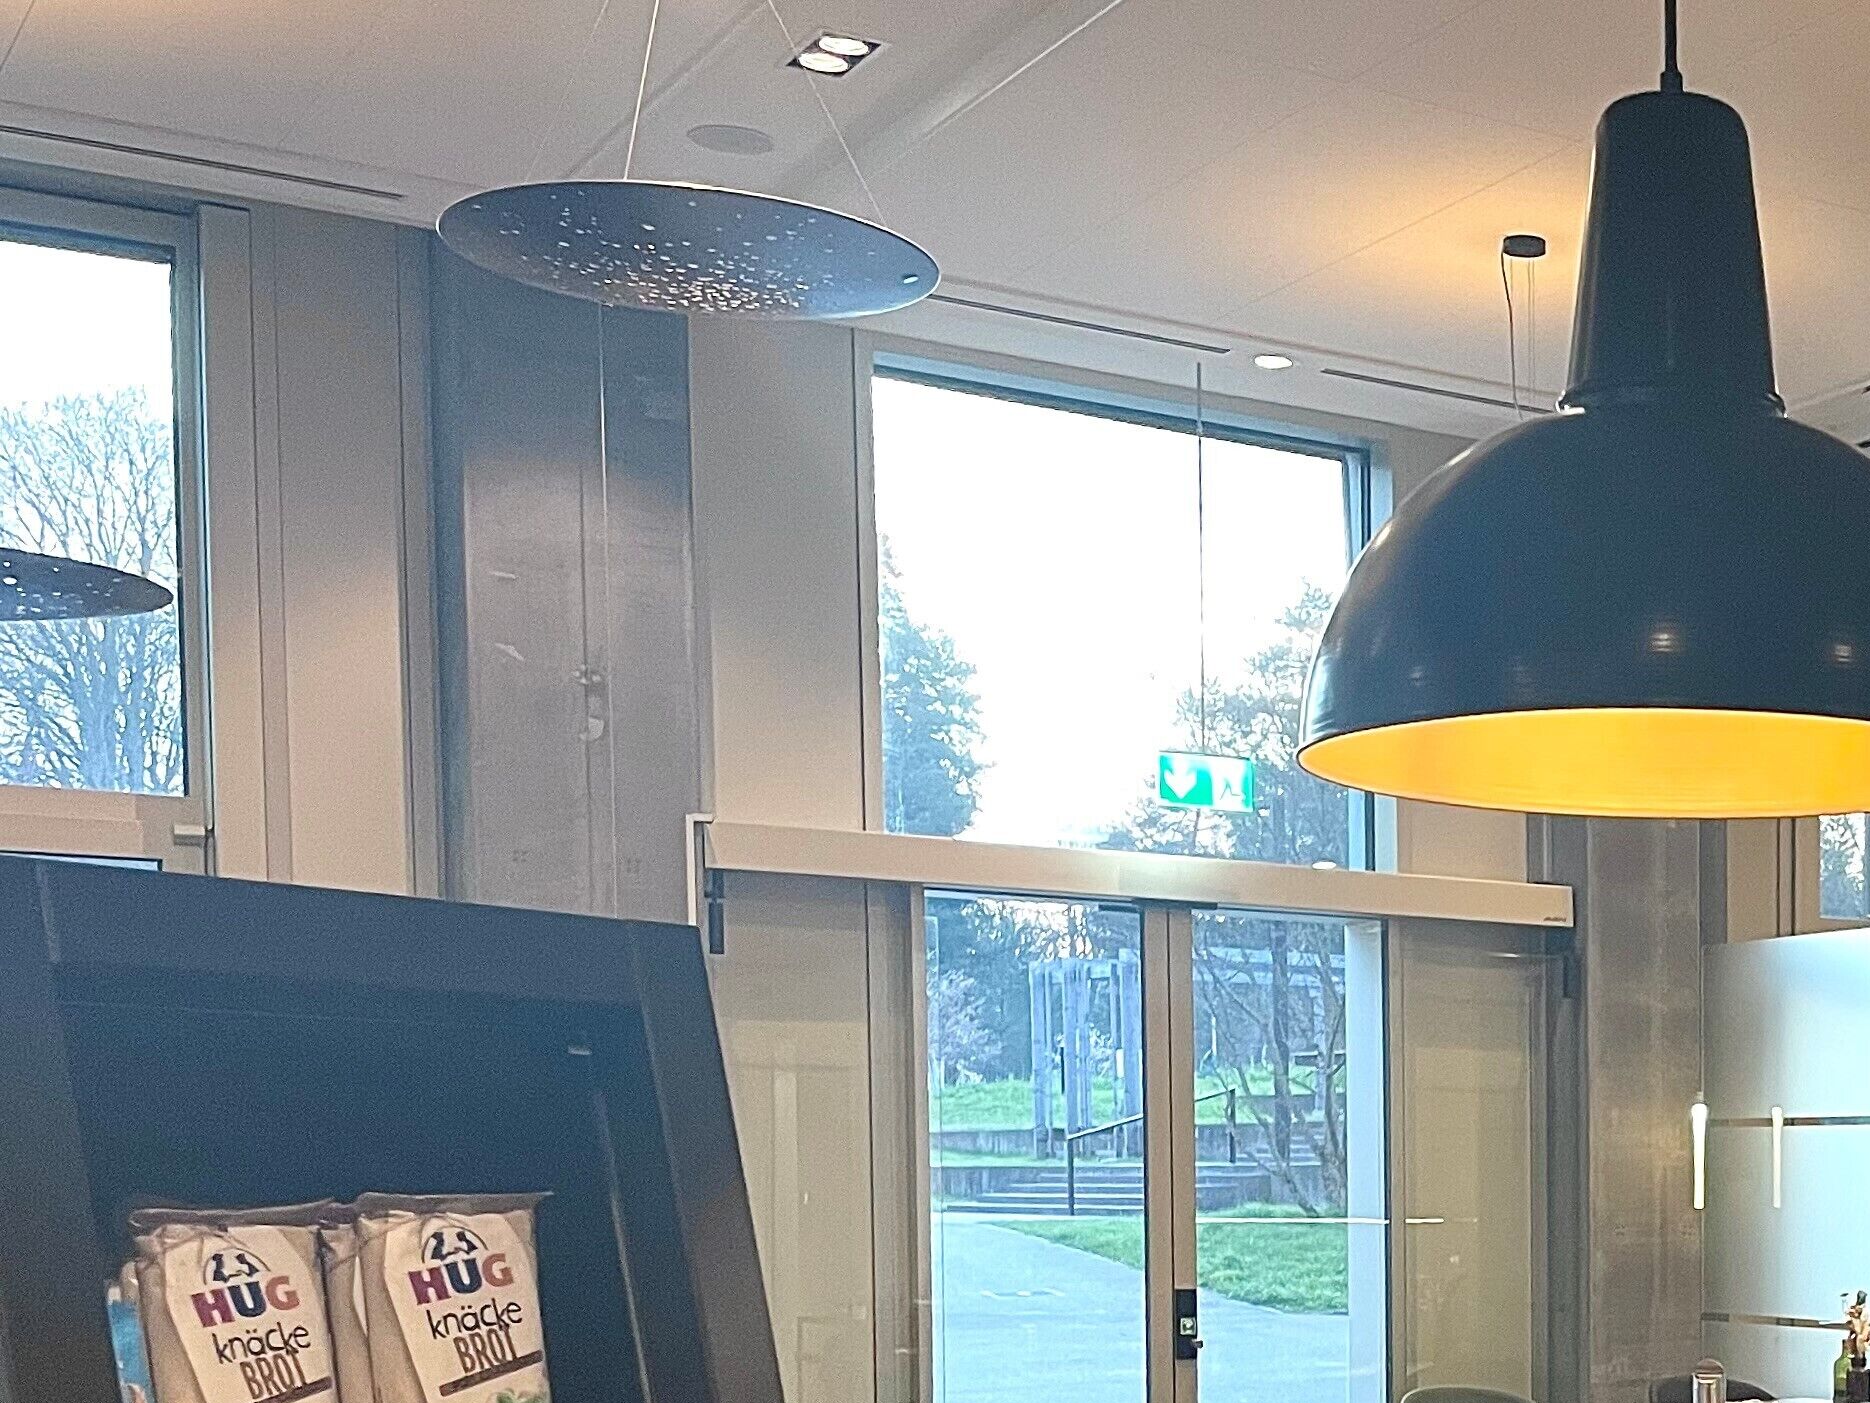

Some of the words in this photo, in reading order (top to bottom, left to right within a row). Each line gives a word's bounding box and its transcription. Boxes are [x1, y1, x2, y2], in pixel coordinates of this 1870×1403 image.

[191, 1275, 300, 1328] HUG
[408, 1252, 514, 1306] HUG
[212, 1321, 311, 1364] knäcke
[426, 1297, 523, 1340] knäcke
[239, 1348, 308, 1400] BROT
[453, 1323, 518, 1374] BROT
